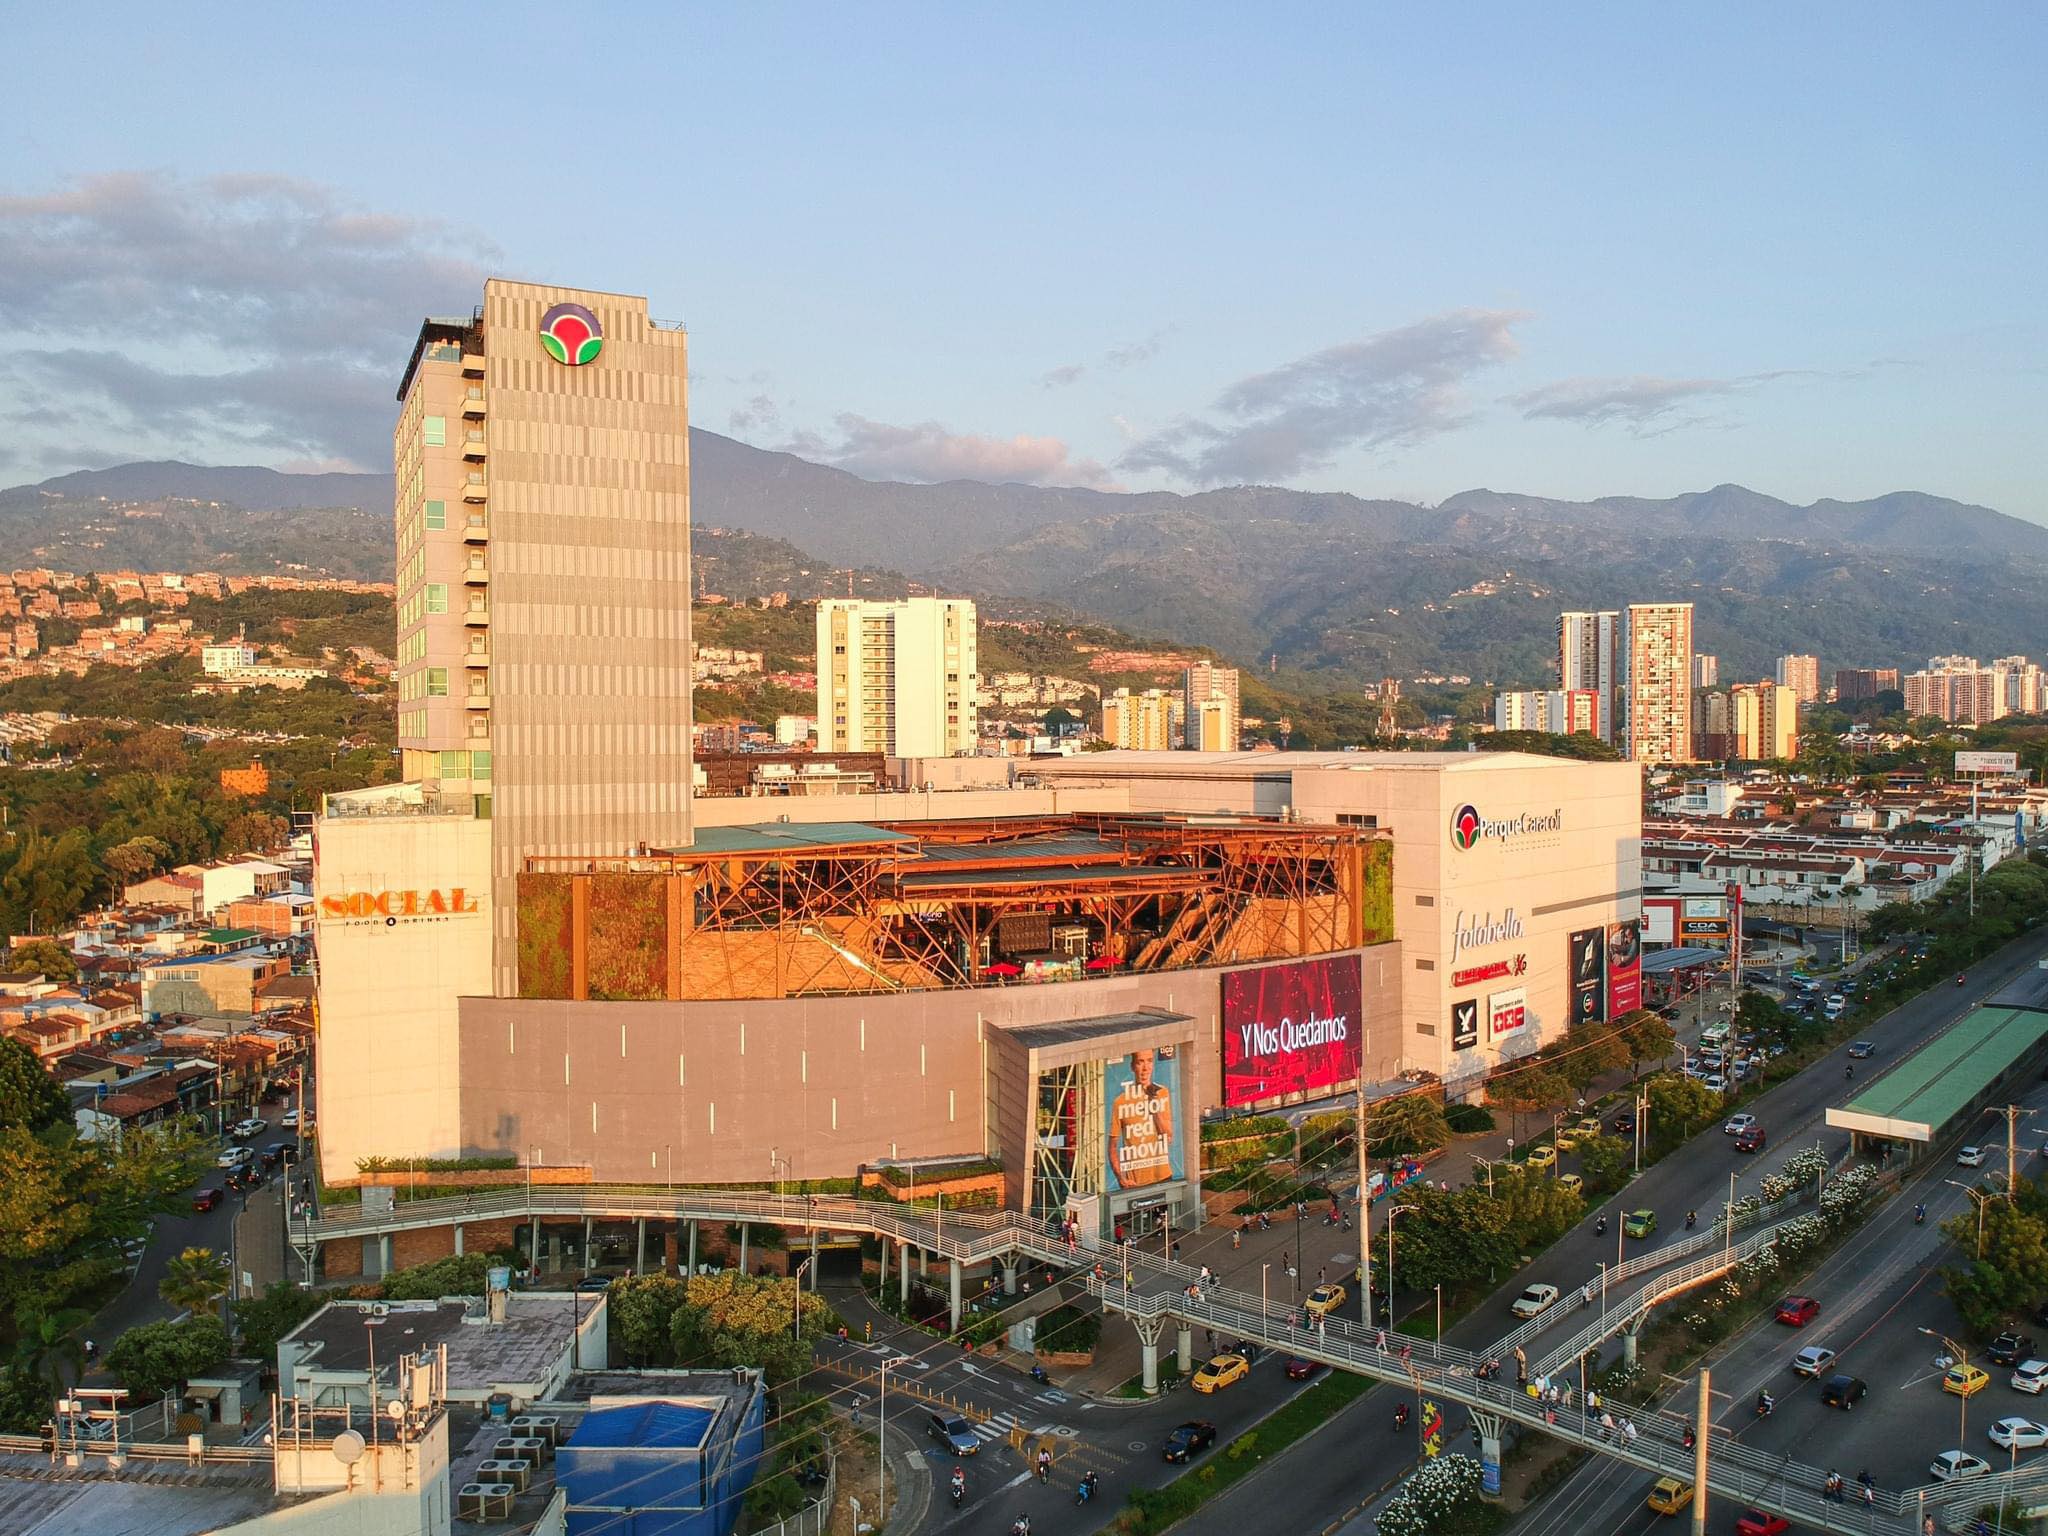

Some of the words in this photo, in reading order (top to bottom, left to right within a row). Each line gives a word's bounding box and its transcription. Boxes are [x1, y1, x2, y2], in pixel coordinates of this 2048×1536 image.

[321, 888, 478, 918] SOCIAL
[1242, 1024, 1251, 1057] Y
[1253, 1021, 1278, 1056] Nos
[1280, 1011, 1346, 1053] Quedamos
[1121, 1081, 1142, 1101] Tu
[1118, 1095, 1168, 1119] mejor
[1126, 1119, 1154, 1139] red
[1120, 1133, 1168, 1162] móvil
